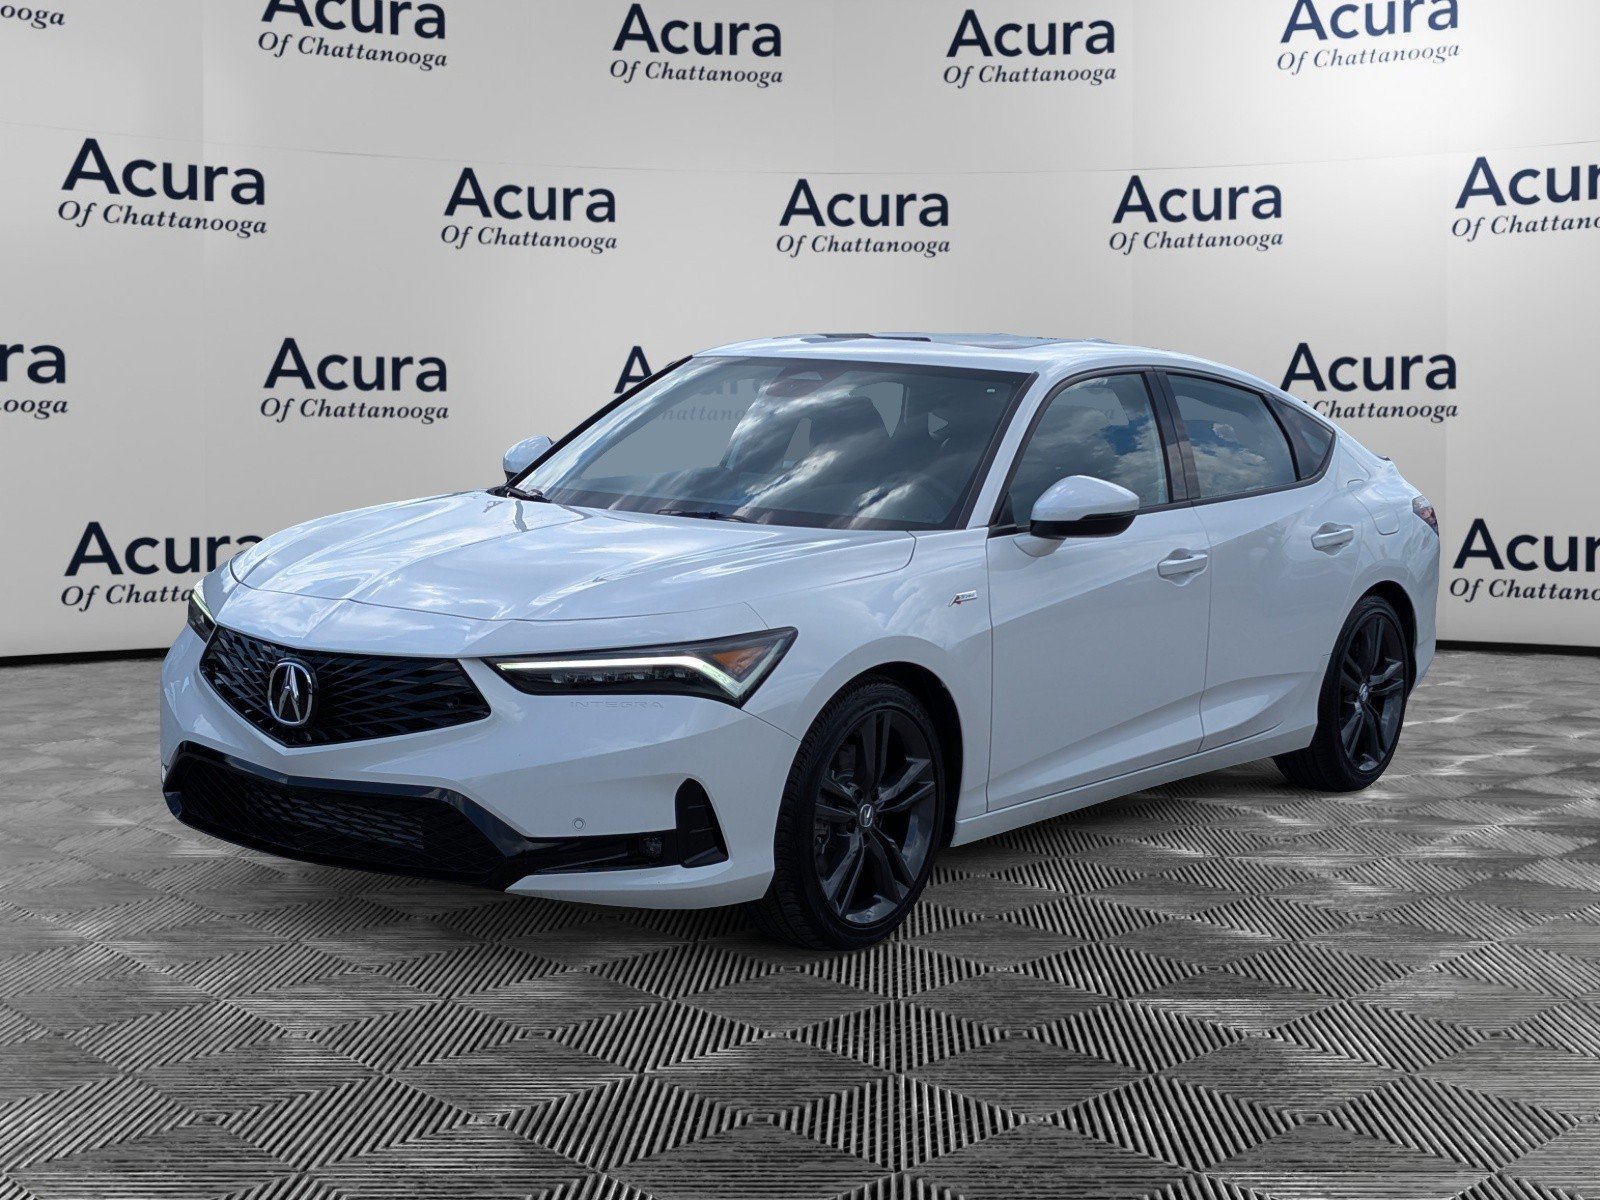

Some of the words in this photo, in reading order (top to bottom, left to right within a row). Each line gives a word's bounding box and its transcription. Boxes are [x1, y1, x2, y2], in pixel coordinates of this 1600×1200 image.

[261, 0, 446, 40] Acura
[612, 3, 782, 57] Acura
[946, 9, 1116, 58] Acura
[1280, 0, 1459, 44] Acura
[258, 32, 293, 58] Of
[298, 36, 447, 71] Chattanooga
[1276, 52, 1309, 75] Of
[1314, 45, 1460, 68] Chattanooga
[610, 60, 641, 83] Of
[645, 61, 784, 88] Chattanooga
[943, 65, 974, 89] Of
[979, 65, 1117, 87] Chattanooga
[61, 138, 265, 205] Acura
[1455, 156, 1600, 209] Acur
[443, 167, 617, 223] Acura
[779, 178, 950, 228] Acura
[1112, 175, 1283, 225] Acura
[58, 201, 97, 228] Of
[103, 204, 268, 239] Chattanooga
[1451, 217, 1485, 242] Of
[1491, 214, 1600, 235] Chattano
[441, 225, 473, 249] Of
[478, 227, 618, 254] Chattanooga
[776, 235, 807, 258] Of
[811, 235, 950, 258] Chattanooga
[1109, 232, 1140, 255] Of
[1143, 231, 1283, 252] Chattanooga
[263, 337, 448, 392] Acura
[1280, 342, 1457, 392] Acura
[260, 398, 295, 423] Of
[300, 398, 450, 426] Chattanooga
[1313, 400, 1459, 424] Chattanooga
[1453, 518, 1600, 572] Acur
[61, 585, 100, 612] Of
[106, 584, 193, 606] Chatta
[1450, 578, 1484, 603] Of
[1489, 578, 1600, 602] Chattano
[570, 701, 665, 709] INTEGRA
